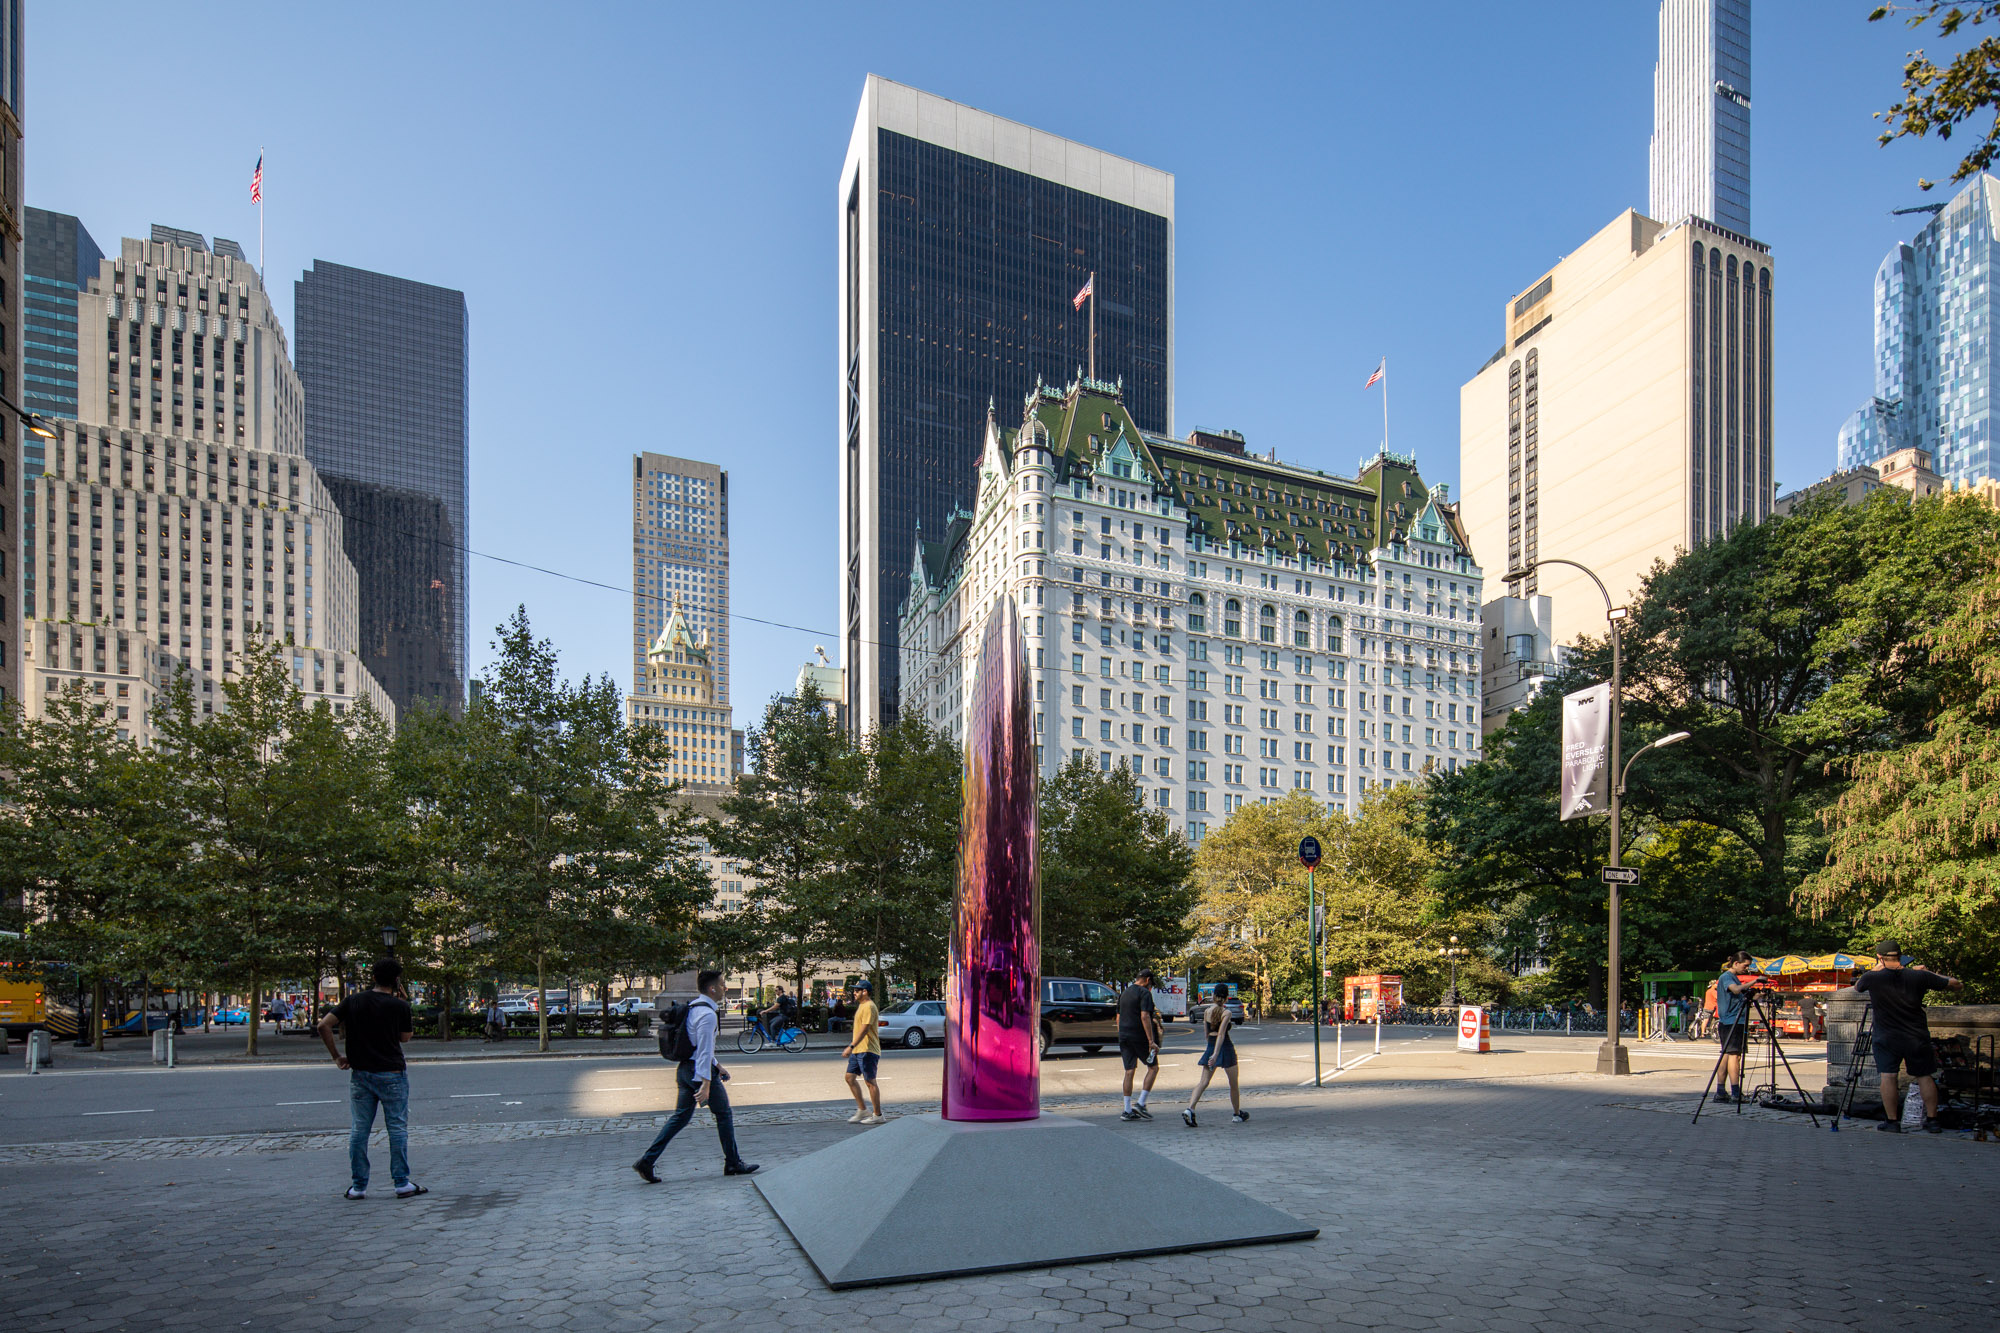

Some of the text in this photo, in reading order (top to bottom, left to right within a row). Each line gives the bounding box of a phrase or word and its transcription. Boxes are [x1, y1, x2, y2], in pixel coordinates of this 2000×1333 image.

[1578, 696, 1594, 706] NYC
[1566, 742, 1585, 752] FRED
[1565, 745, 1605, 760] EVERSLEY
[1565, 754, 1604, 768] PARABOLIC
[1583, 762, 1604, 772] LIGHT
